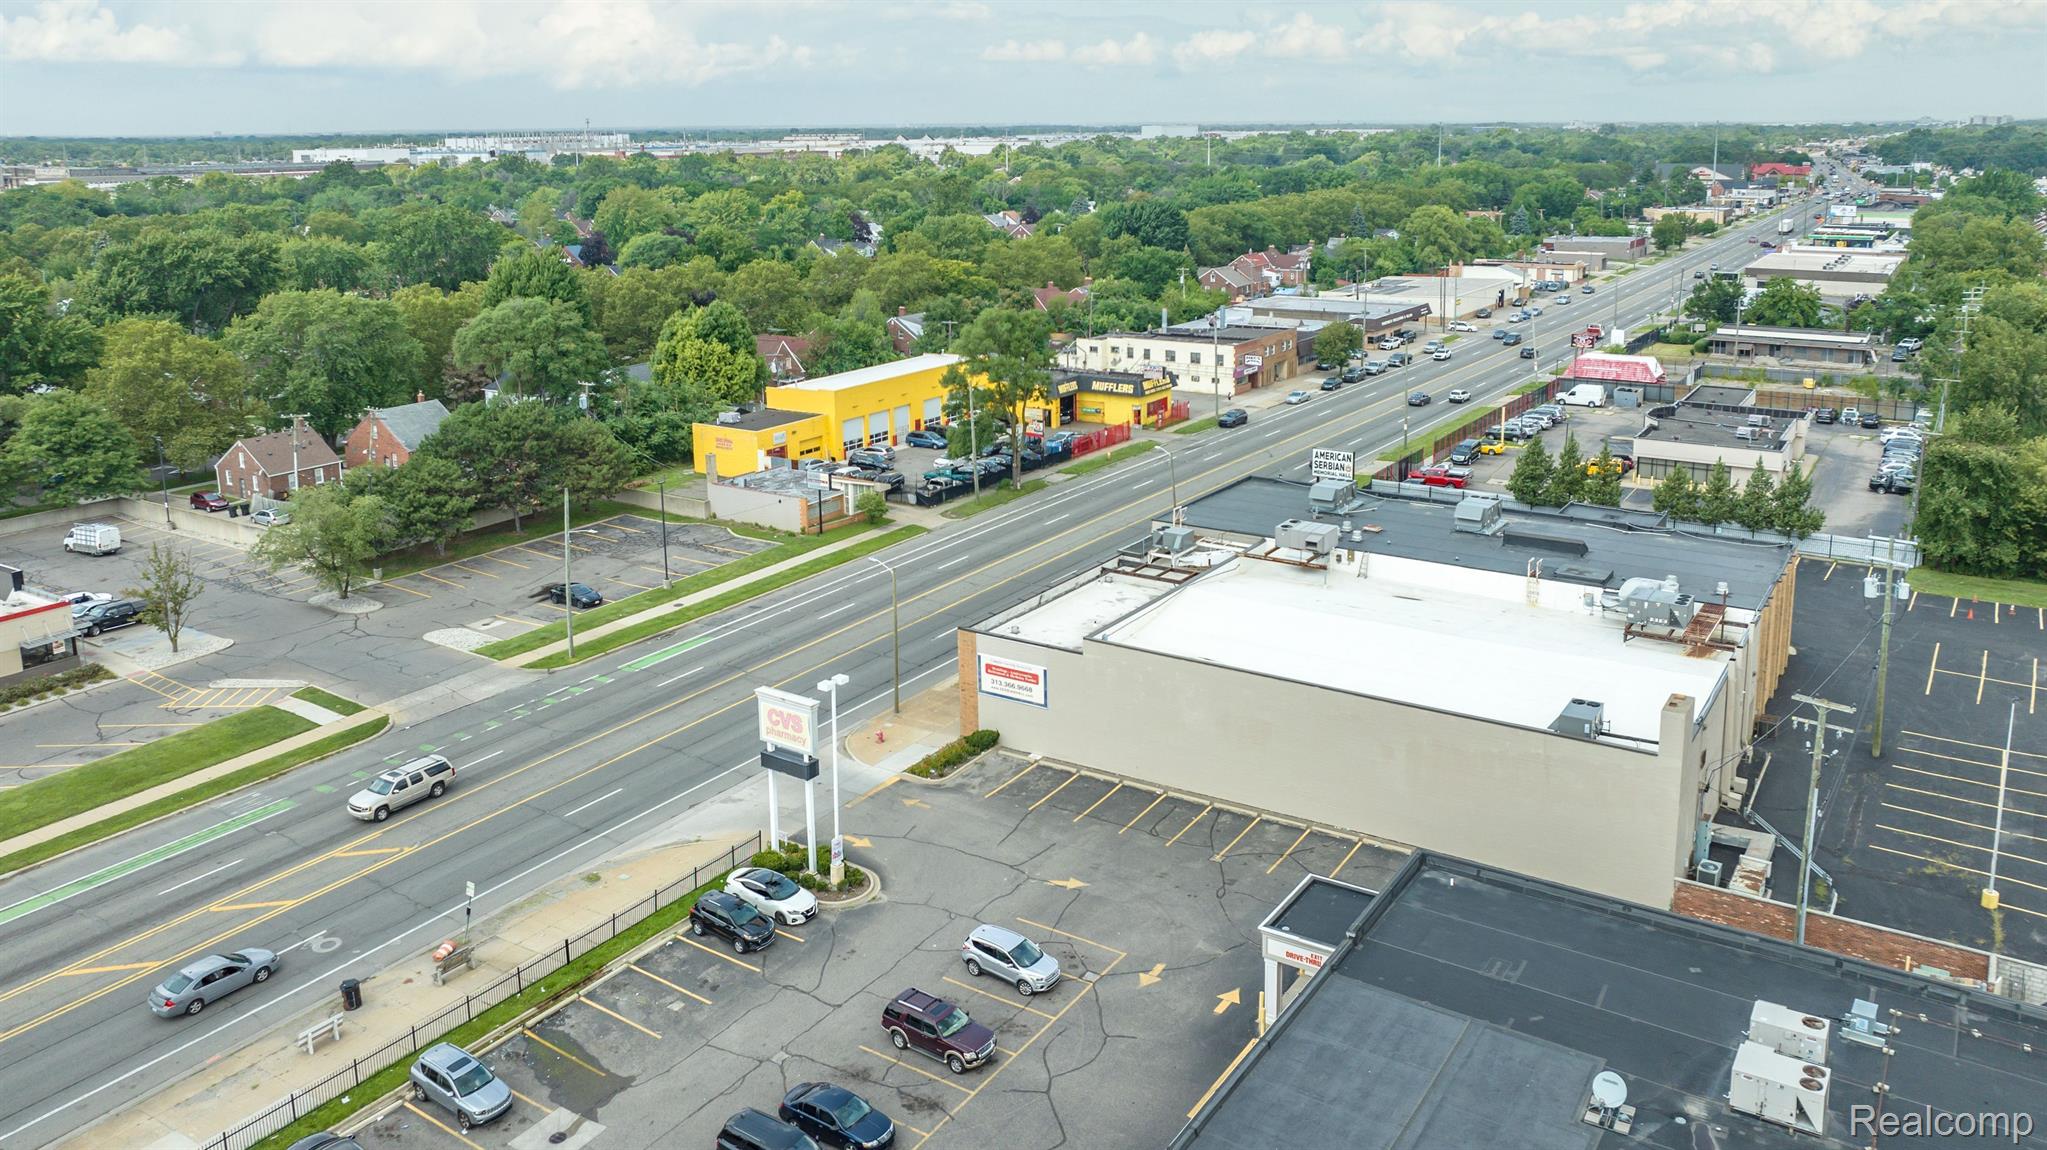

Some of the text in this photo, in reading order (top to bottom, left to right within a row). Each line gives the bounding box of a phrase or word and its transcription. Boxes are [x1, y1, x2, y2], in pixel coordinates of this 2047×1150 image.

[1091, 380, 1135, 394] MUFFLERS
[1314, 450, 1352, 463] AMERICAN
[1313, 460, 1345, 472] SERBIAN
[1313, 469, 1337, 477] MEMORIAL
[767, 707, 805, 734] CVS
[765, 726, 807, 747] pharmacy
[1285, 950, 1322, 968] DRIVE-THRU
[1310, 953, 1323, 961] EXIT
